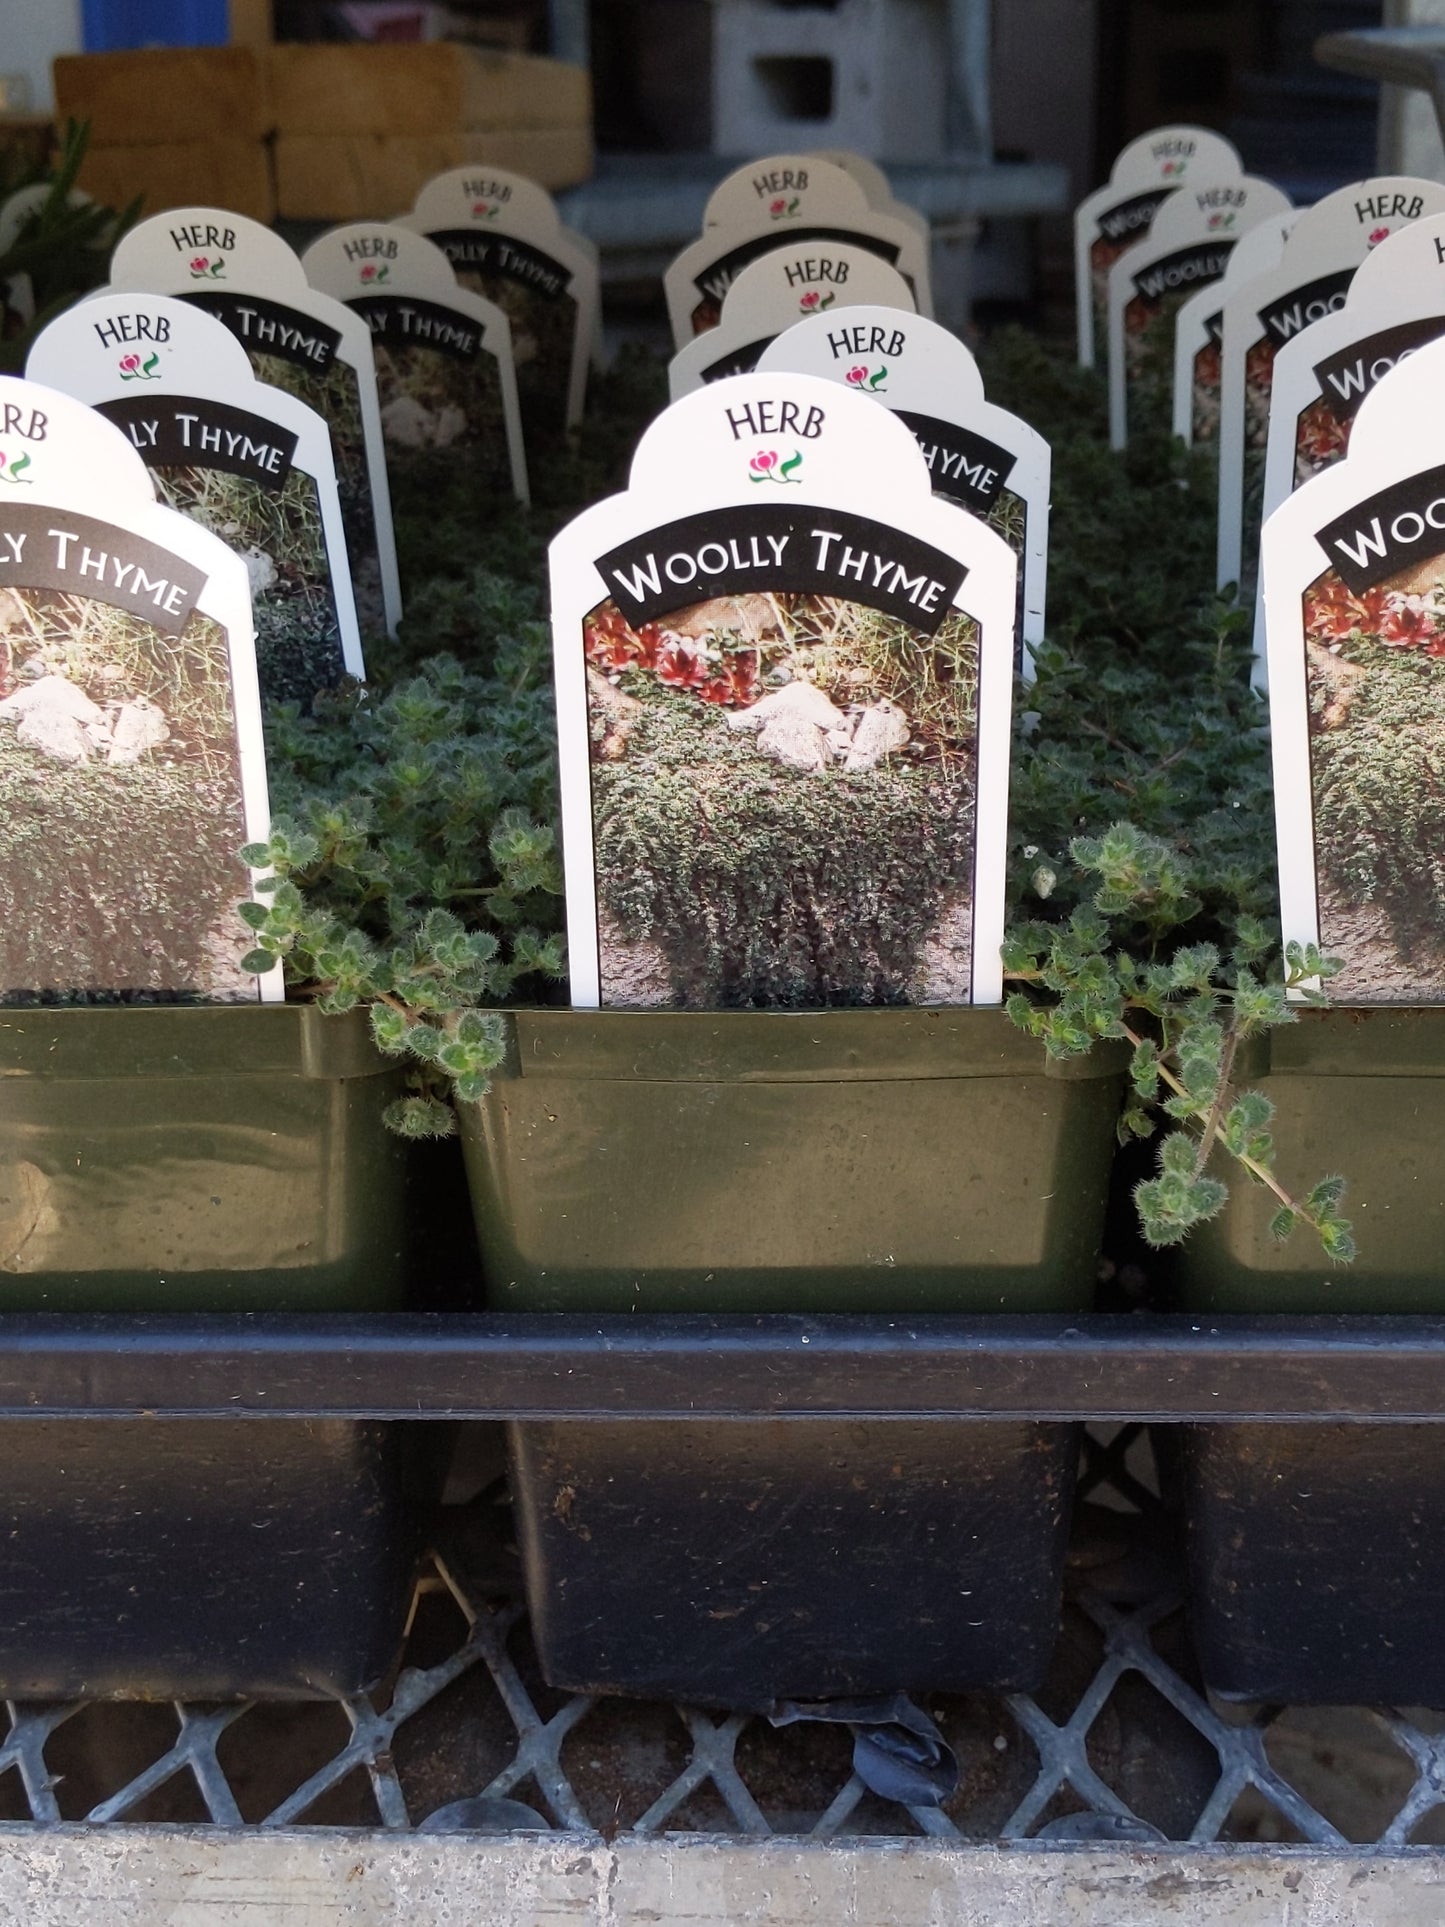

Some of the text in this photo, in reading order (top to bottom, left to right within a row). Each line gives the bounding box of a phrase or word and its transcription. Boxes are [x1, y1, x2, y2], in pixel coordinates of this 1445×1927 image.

[462, 180, 513, 204] HERB
[753, 170, 809, 199] HERB
[1354, 194, 1424, 223] HERB
[170, 225, 236, 252] HERB
[342, 238, 399, 262] HERB
[784, 259, 849, 287] HERB
[94, 314, 171, 349] HERB
[236, 306, 330, 364] THYME
[398, 308, 475, 353] THYME
[827, 326, 906, 359] HERB
[0, 403, 48, 442] RB
[725, 400, 826, 441] HERB
[175, 413, 284, 474] THYME
[911, 431, 999, 495] HYME
[48, 529, 188, 616] THYME
[612, 529, 947, 614] WOOLLY THYME
